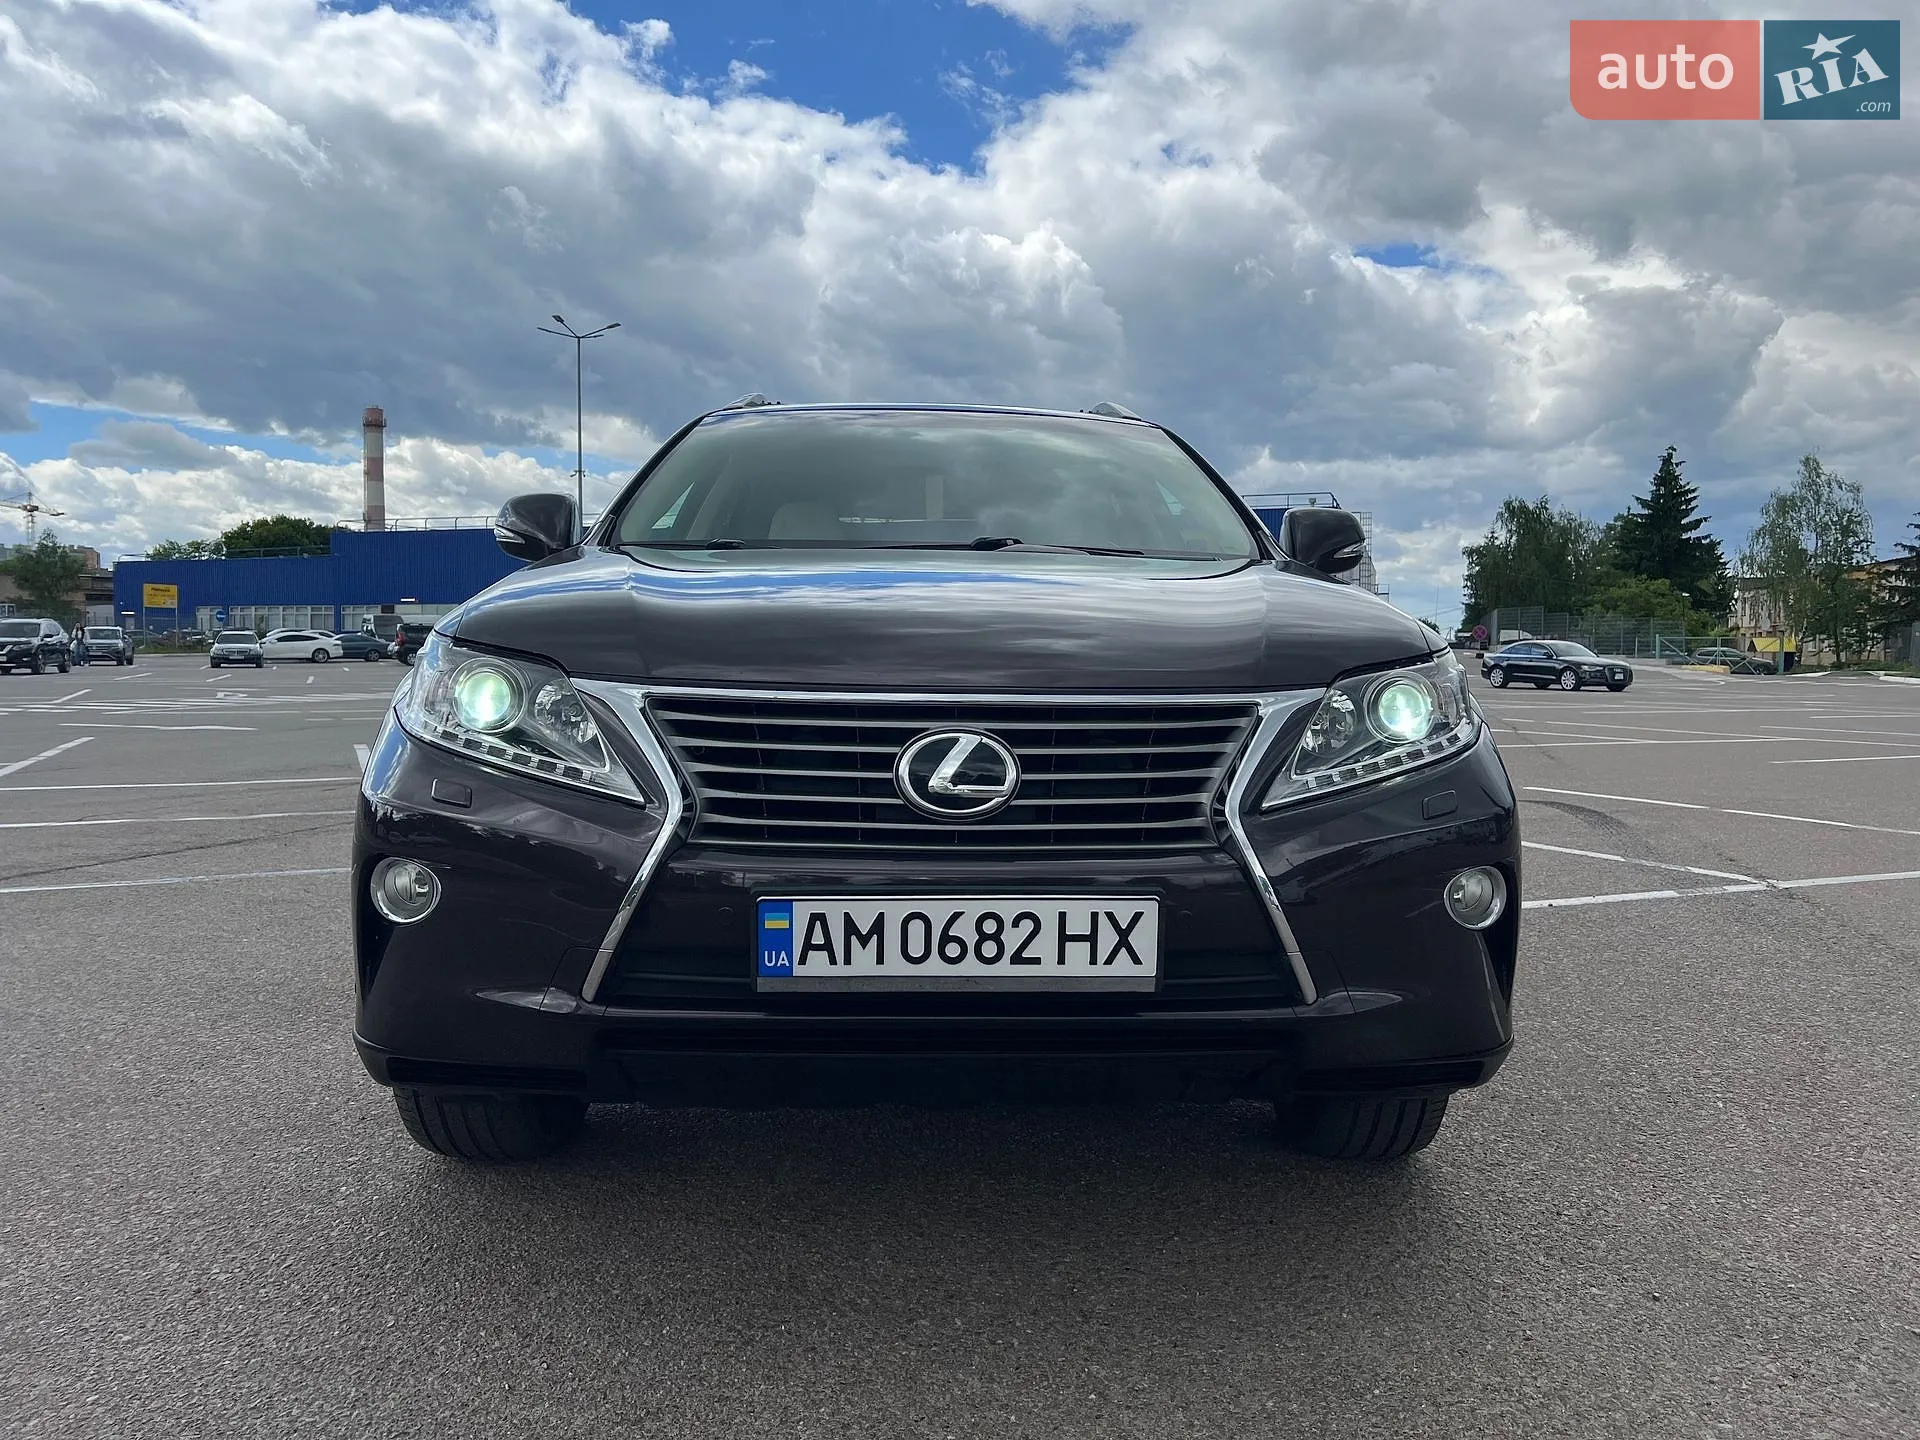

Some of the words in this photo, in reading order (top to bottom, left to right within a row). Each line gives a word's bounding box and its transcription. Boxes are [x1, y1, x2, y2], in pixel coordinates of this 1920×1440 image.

[797, 911, 885, 966] AM
[900, 911, 1042, 966] 0682
[1056, 911, 1145, 966] HX
[764, 951, 790, 967] UA
